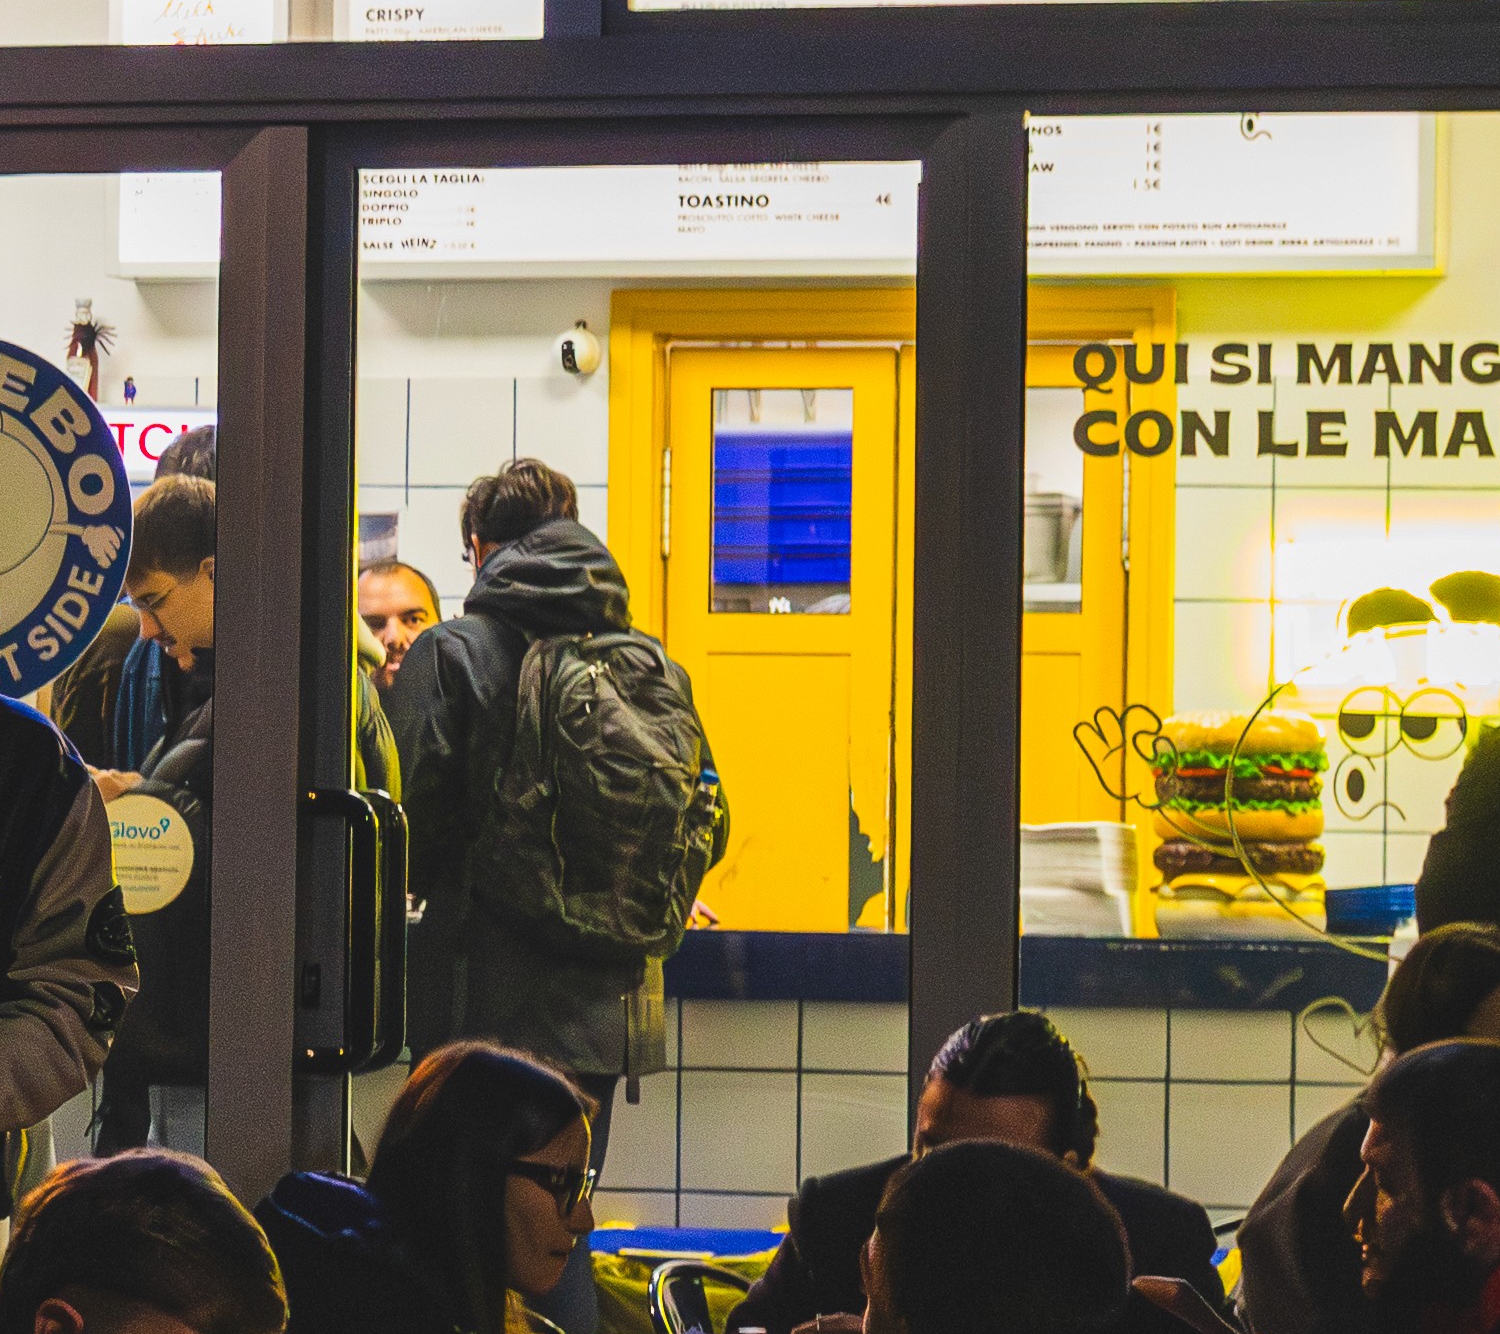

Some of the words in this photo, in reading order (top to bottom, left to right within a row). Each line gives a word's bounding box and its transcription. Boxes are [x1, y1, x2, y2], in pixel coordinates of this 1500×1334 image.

[365, 7, 425, 22] CRISPY
[361, 173, 408, 185] SCEGLI
[411, 173, 428, 184] LA
[362, 188, 419, 199] SINGOLO
[678, 193, 770, 208] TOASTINO
[361, 202, 410, 213] DOPPIO
[361, 217, 403, 226] TRIPLO
[362, 240, 394, 251] SALSE
[399, 236, 438, 251] HEINZ
[1072, 342, 1190, 394] QUI
[1209, 343, 1273, 385] SI
[1073, 410, 1231, 458] CON
[1257, 410, 1349, 457] LE
[27, 565, 105, 663] SIDE
